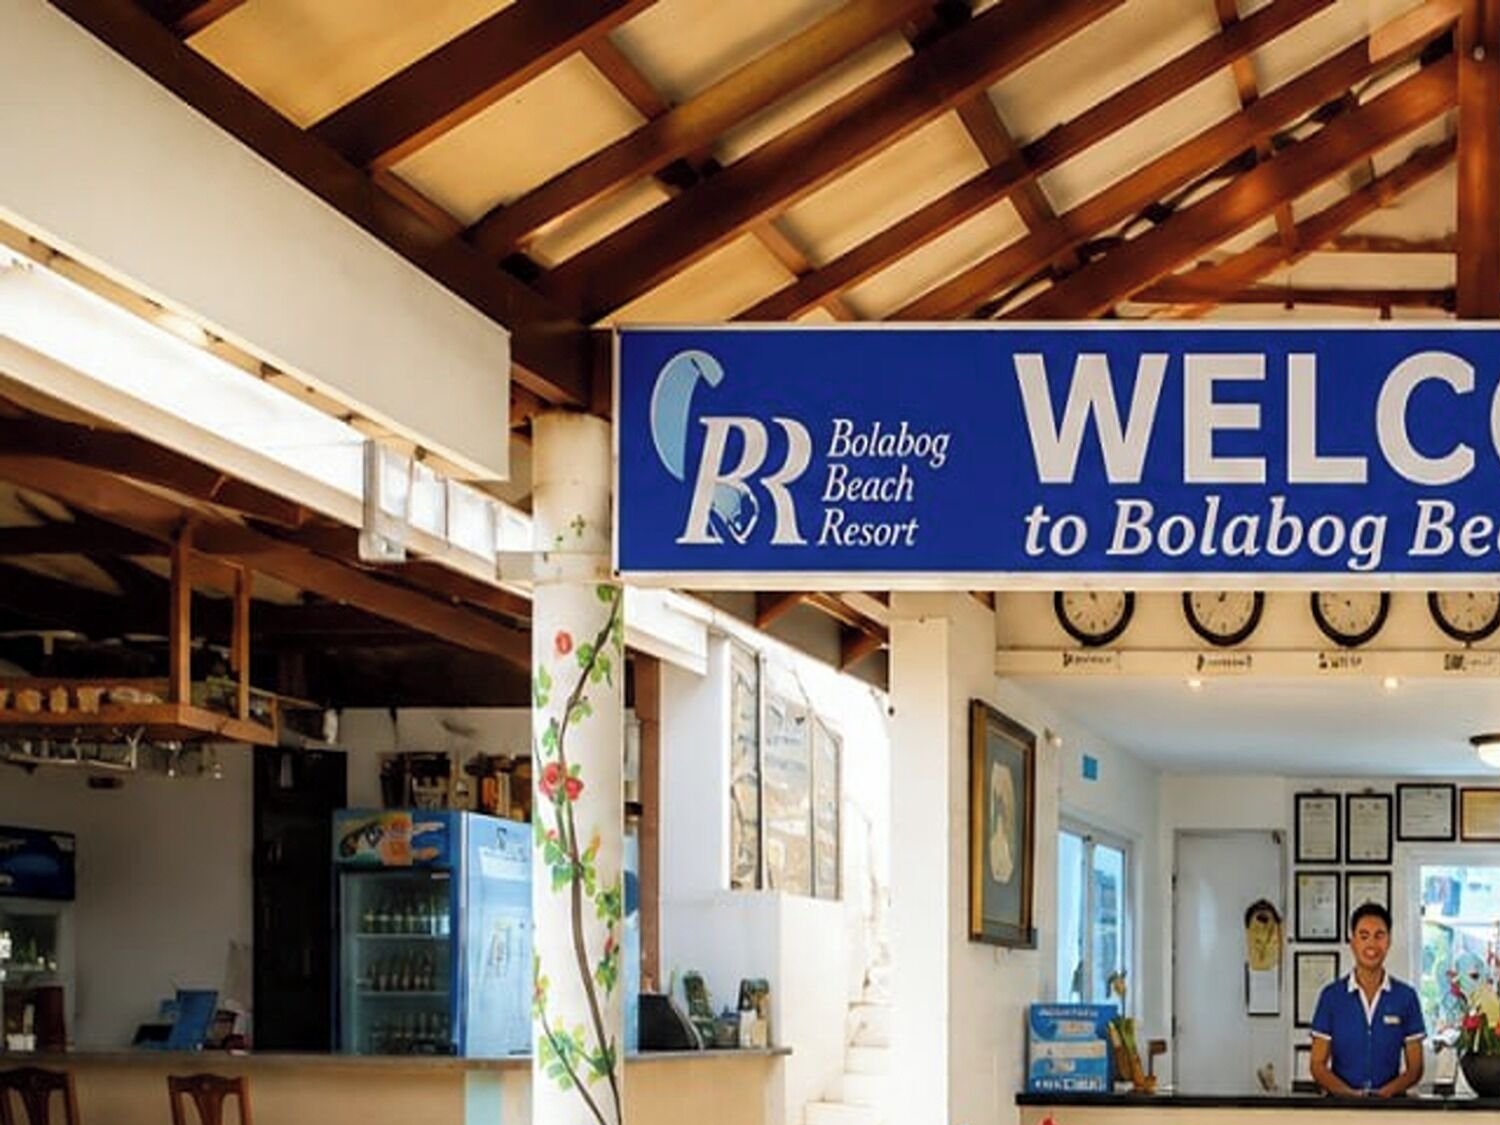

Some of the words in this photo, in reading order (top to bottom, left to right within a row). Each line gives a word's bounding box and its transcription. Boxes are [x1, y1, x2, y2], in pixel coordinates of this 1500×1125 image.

[826, 417, 951, 469] Bolabog
[821, 463, 915, 502] Beach
[817, 508, 920, 547] Resort
[1025, 504, 1087, 556] to
[1105, 496, 1388, 572] Bolabog
